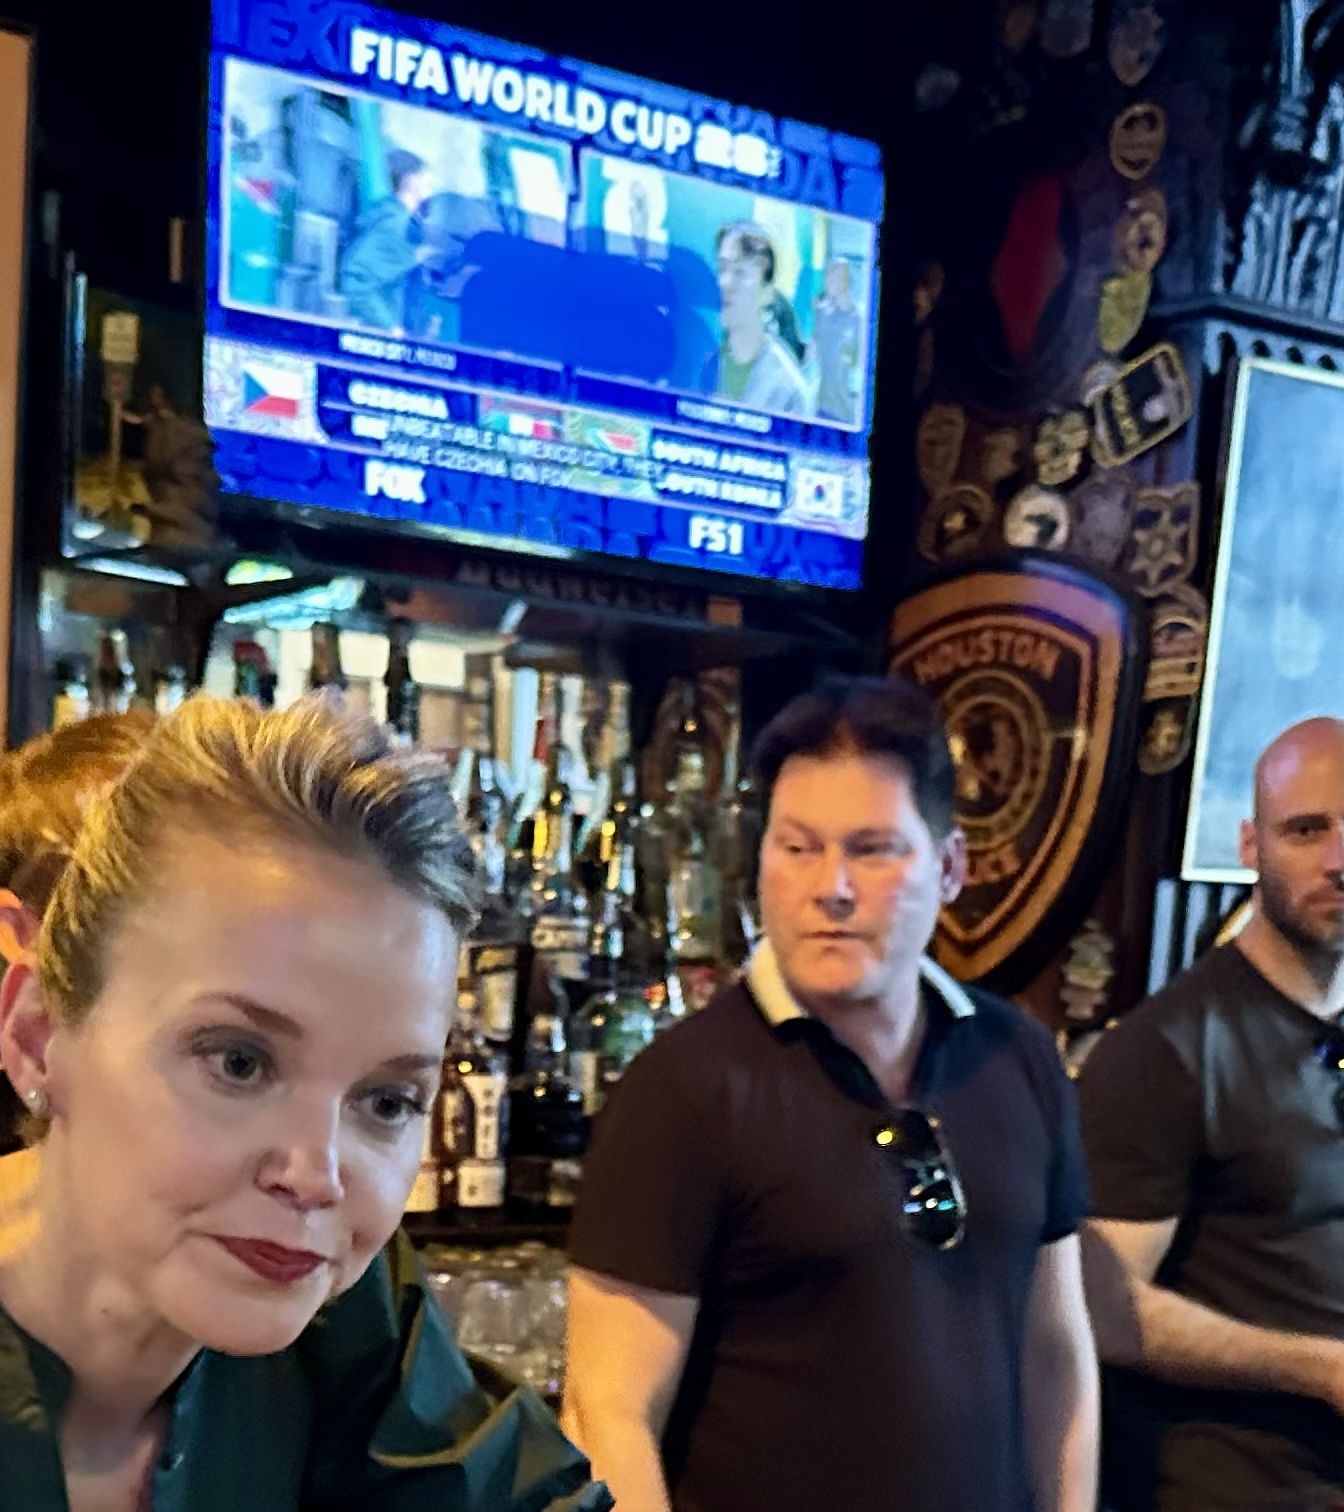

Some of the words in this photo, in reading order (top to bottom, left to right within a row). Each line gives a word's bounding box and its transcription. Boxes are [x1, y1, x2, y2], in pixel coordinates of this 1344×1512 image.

[350, 27, 449, 96] FIFA
[451, 53, 606, 136] WORLD
[610, 99, 693, 155] CUP
[364, 458, 426, 503] FOX
[688, 513, 746, 556] FS1
[912, 627, 1060, 686] HOUSTON
